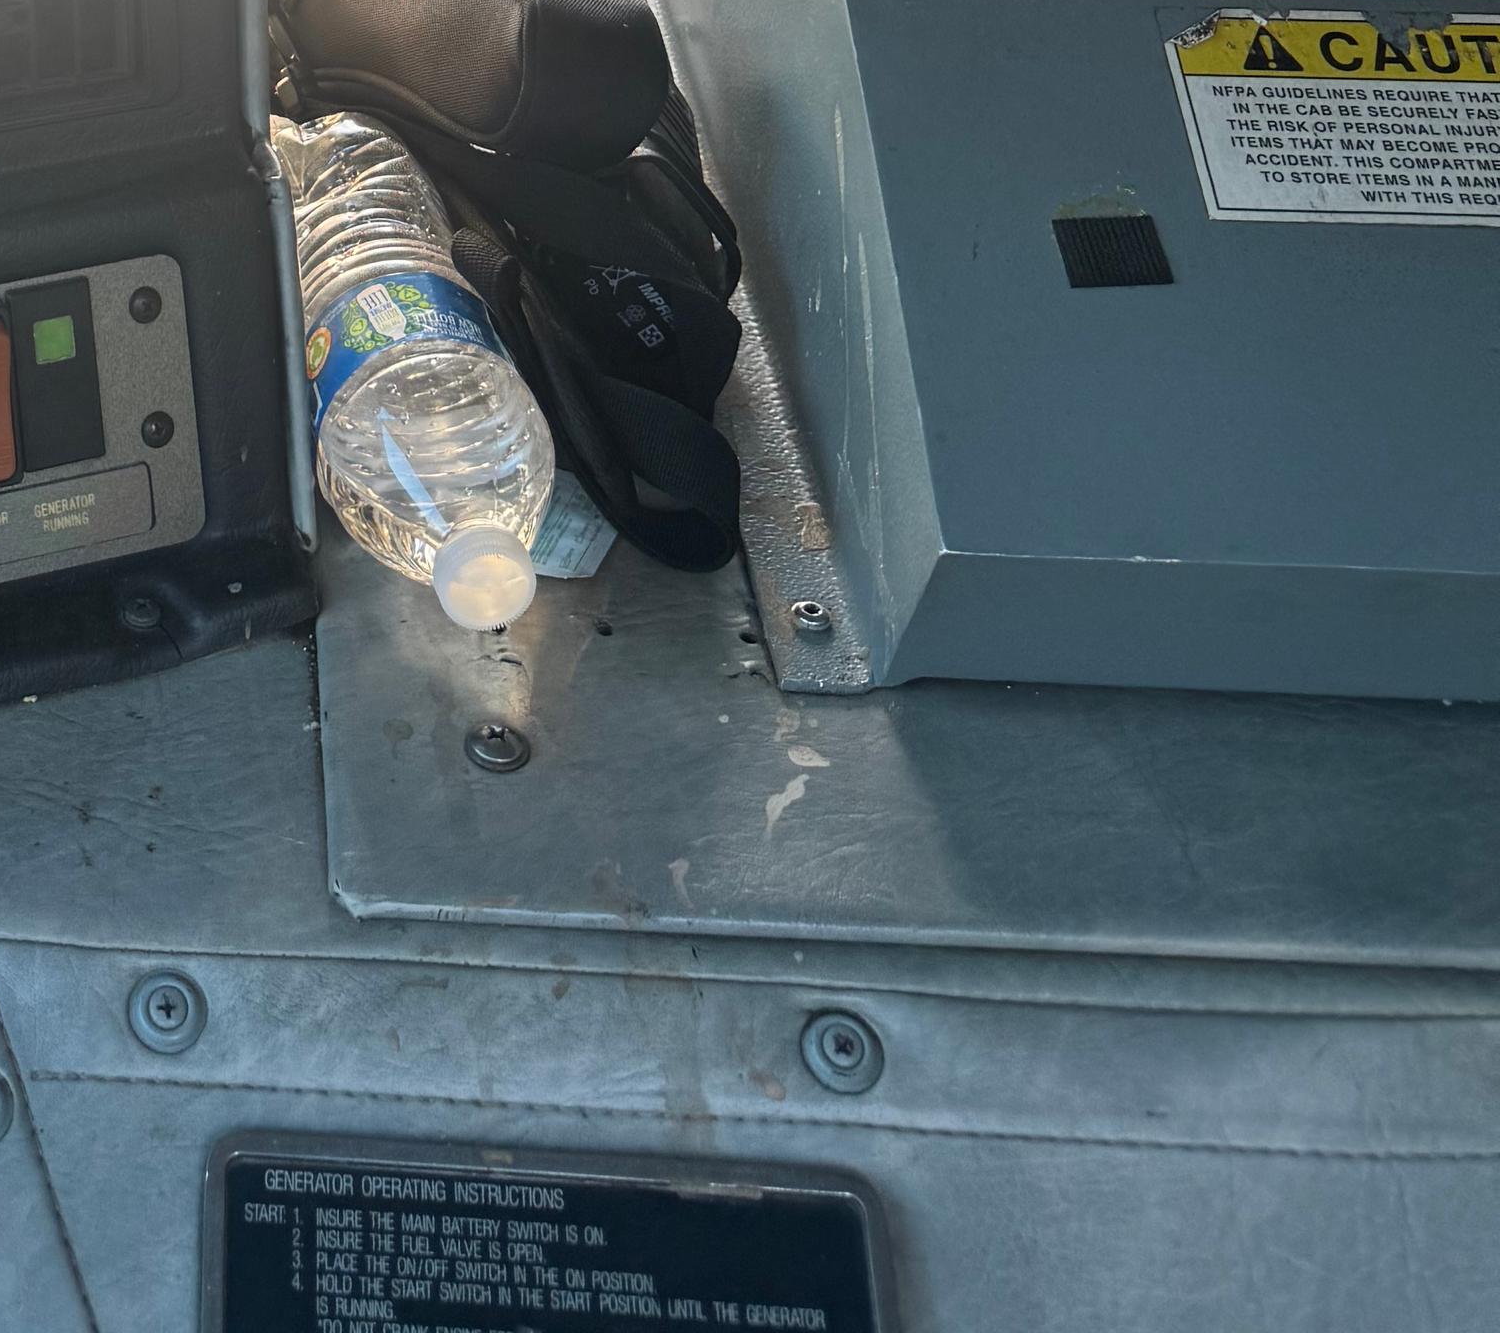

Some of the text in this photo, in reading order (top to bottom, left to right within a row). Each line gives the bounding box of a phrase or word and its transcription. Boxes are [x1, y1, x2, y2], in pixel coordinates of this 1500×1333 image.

[1212, 85, 1500, 103] NFPA GUIDELINES REQUIRE THAT
[1232, 102, 1500, 120] IN THE CAB BE SECURELY FAS
[1226, 119, 1262, 131] THE
[1267, 120, 1309, 132] RISK
[1314, 121, 1338, 133] OF
[1343, 122, 1440, 135] PERSONAL
[1230, 136, 1284, 149] ITEMS
[1288, 137, 1333, 150] THAT
[1340, 139, 1374, 151] MAY
[1382, 140, 1459, 153] BECOME
[1245, 154, 1500, 171] ACCIDENT. THIS COMPARTME
[1260, 171, 1285, 182] TO
[1291, 171, 1351, 184] STORE
[1356, 173, 1411, 186] ITEMS
[1415, 175, 1434, 186] IN
[1441, 176, 1452, 187] A
[1361, 190, 1407, 203] WITH
[1411, 191, 1454, 204] THIS
[639, 280, 678, 328] IMPRE
[34, 493, 96, 518] GENERATOR
[43, 512, 89, 532] RUNNING
[265, 1169, 565, 1211] GENERATOR OPERATING INSTRUCTIONS
[293, 1207, 304, 1225] 1.
[316, 1207, 363, 1229] INSURE
[370, 1211, 394, 1231] THE
[401, 1214, 435, 1233] MAIN
[442, 1216, 501, 1239] BATTERY
[508, 1221, 559, 1242] SWITCH
[565, 1223, 579, 1242] IS
[584, 1226, 608, 1246] ON.
[292, 1228, 547, 1264] 2. INSURE THE FUEL VALVE IS OPEN.
[292, 1251, 658, 1295] 3. PLACE THE ON/OFF SWITCH IN THE ON POSITION.
[292, 1274, 827, 1330] 4. HOLD THE START SWITCH IN THE START POSITION UNTIL THE GENERATOR
[316, 1296, 398, 1320] IS RUNNING.
